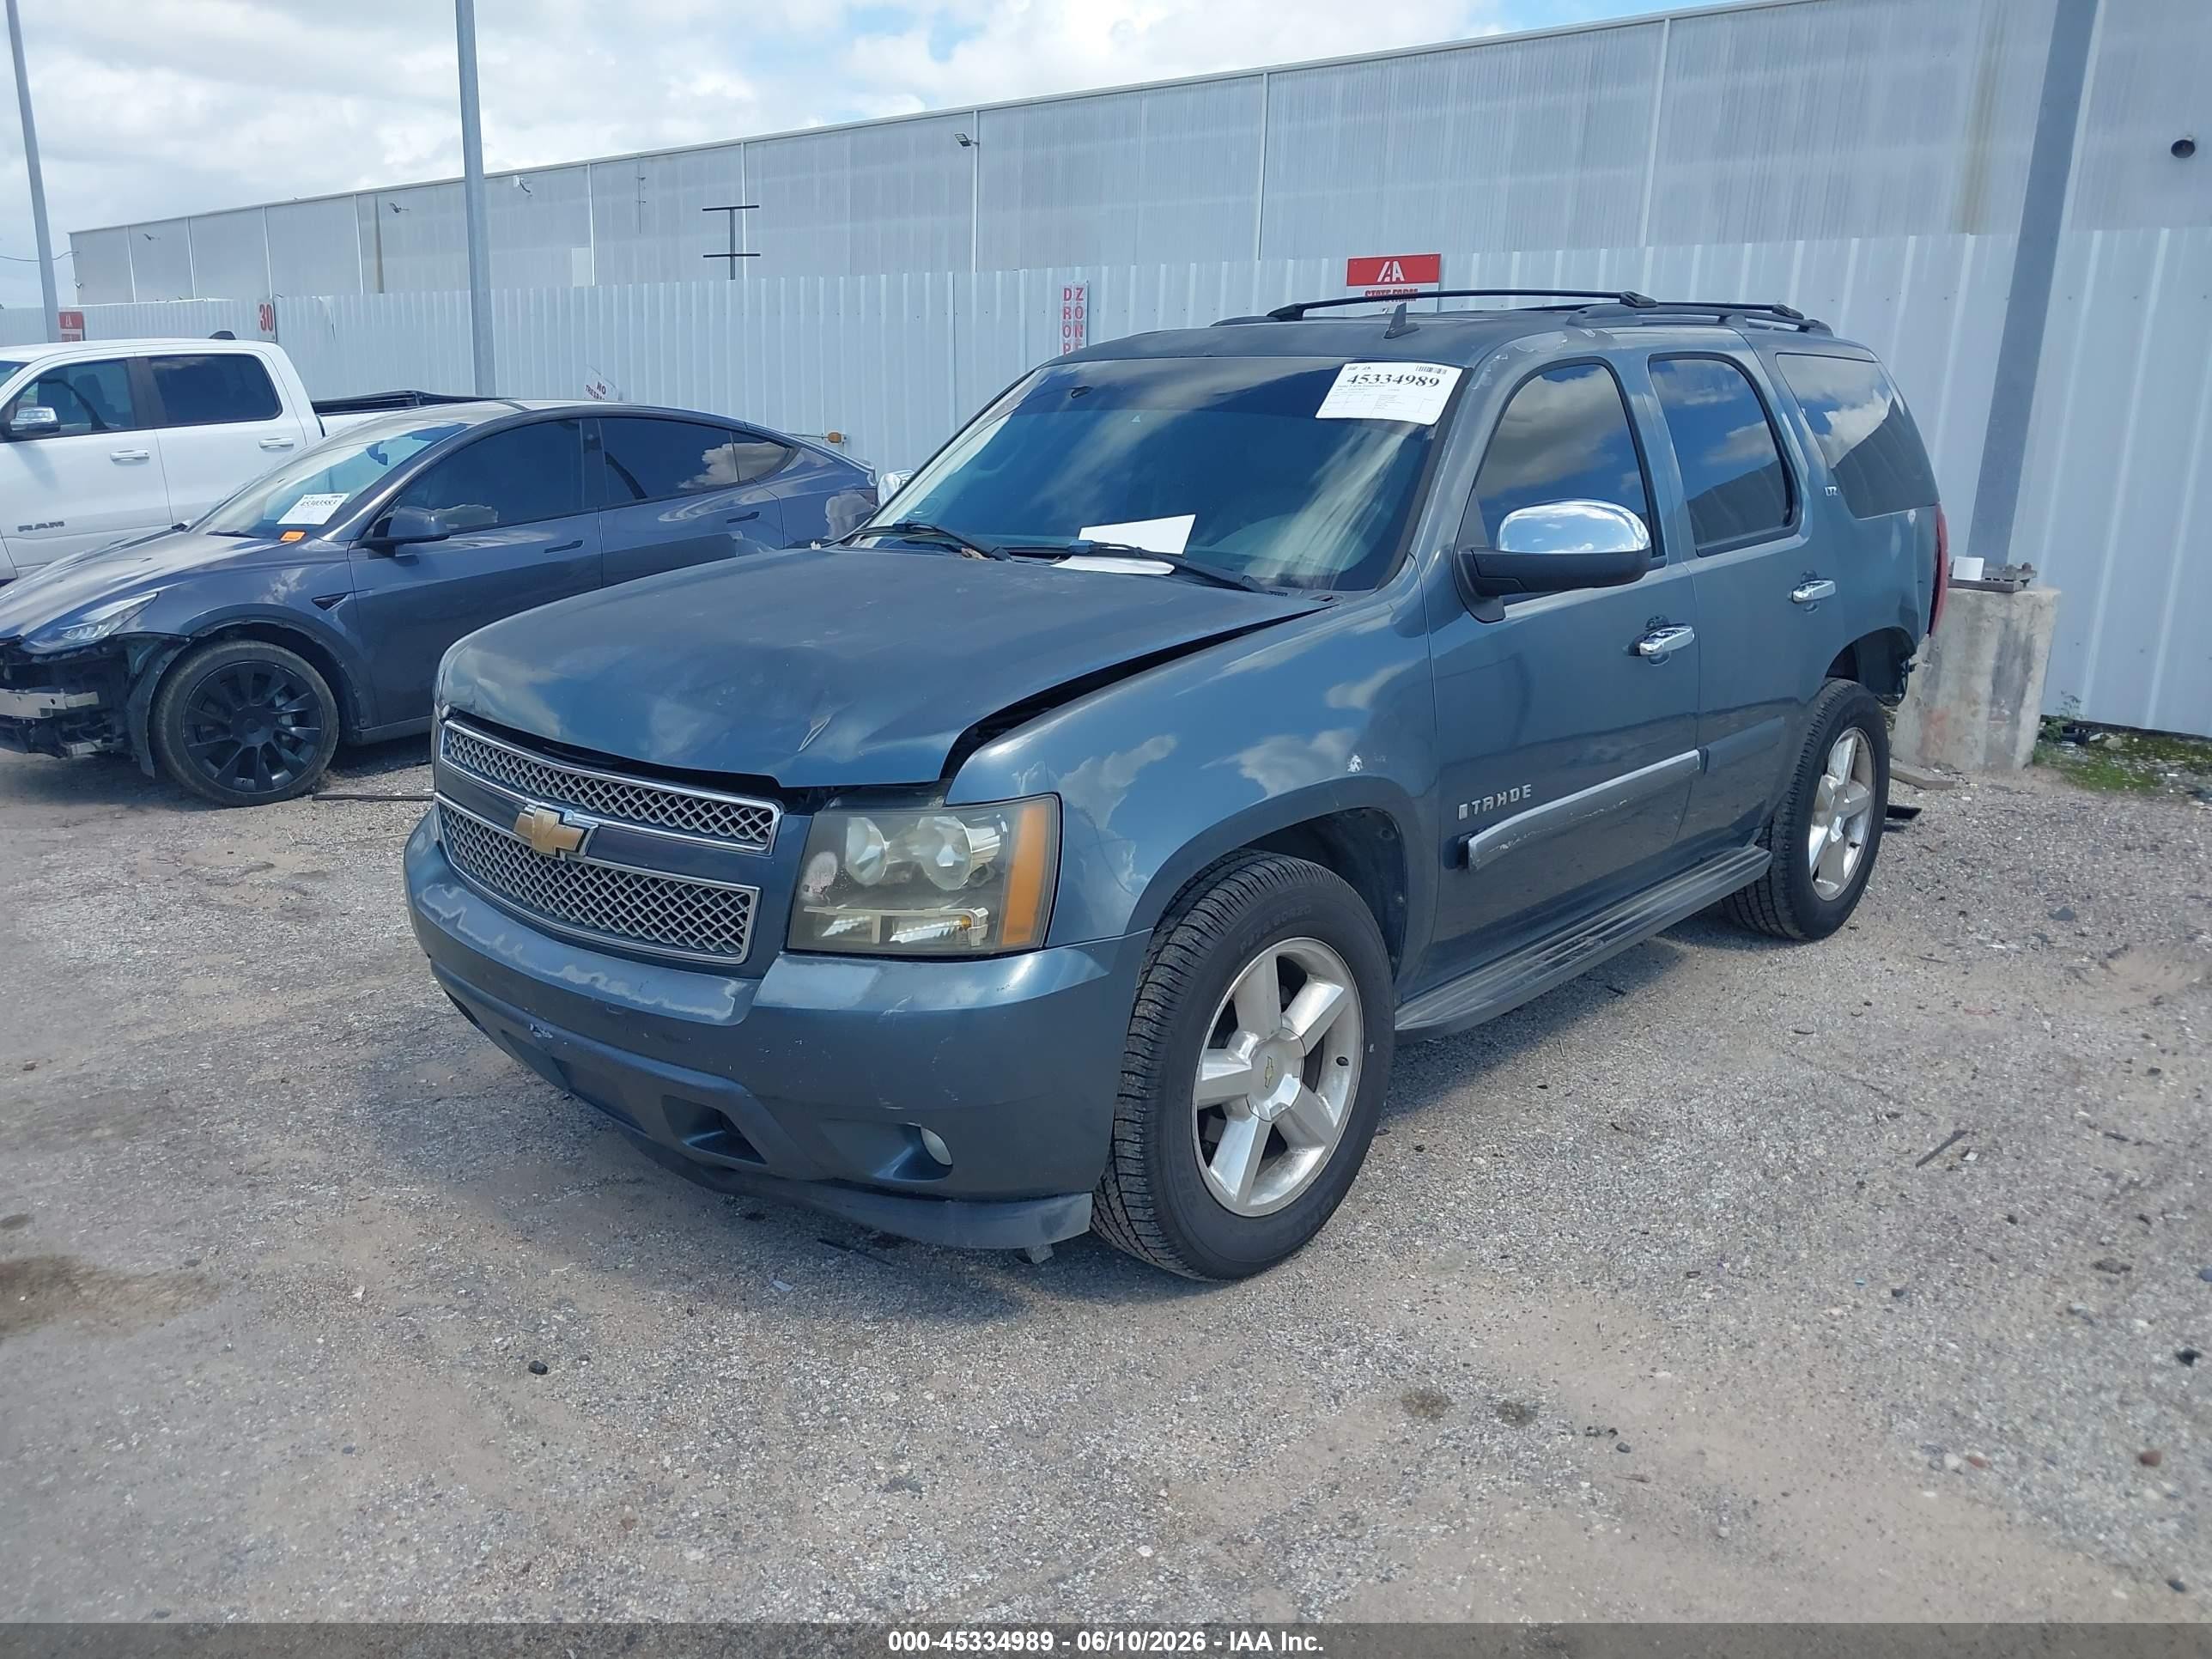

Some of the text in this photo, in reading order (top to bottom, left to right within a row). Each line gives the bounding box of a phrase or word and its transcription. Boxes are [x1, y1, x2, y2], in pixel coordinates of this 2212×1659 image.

[259, 303, 274, 331] 30
[1346, 372, 1441, 388] 45334989
[17, 520, 65, 532] RAM
